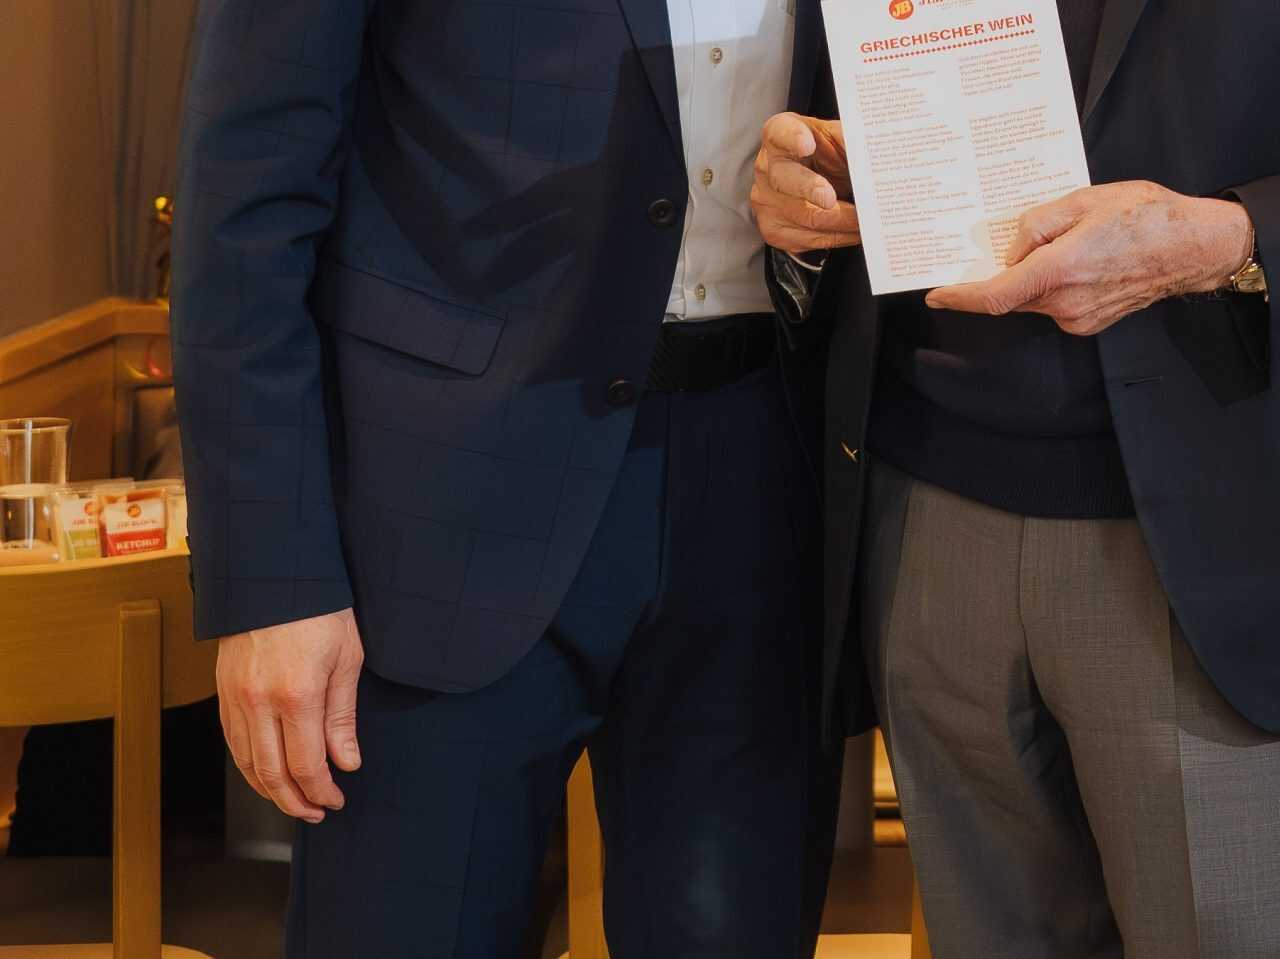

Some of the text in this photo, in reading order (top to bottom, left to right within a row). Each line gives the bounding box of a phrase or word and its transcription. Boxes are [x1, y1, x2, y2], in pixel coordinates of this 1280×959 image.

[892, 2, 912, 18] JB
[860, 13, 1033, 54] GRIECHISCHER WEIN
[116, 538, 160, 550] KETCHUP
